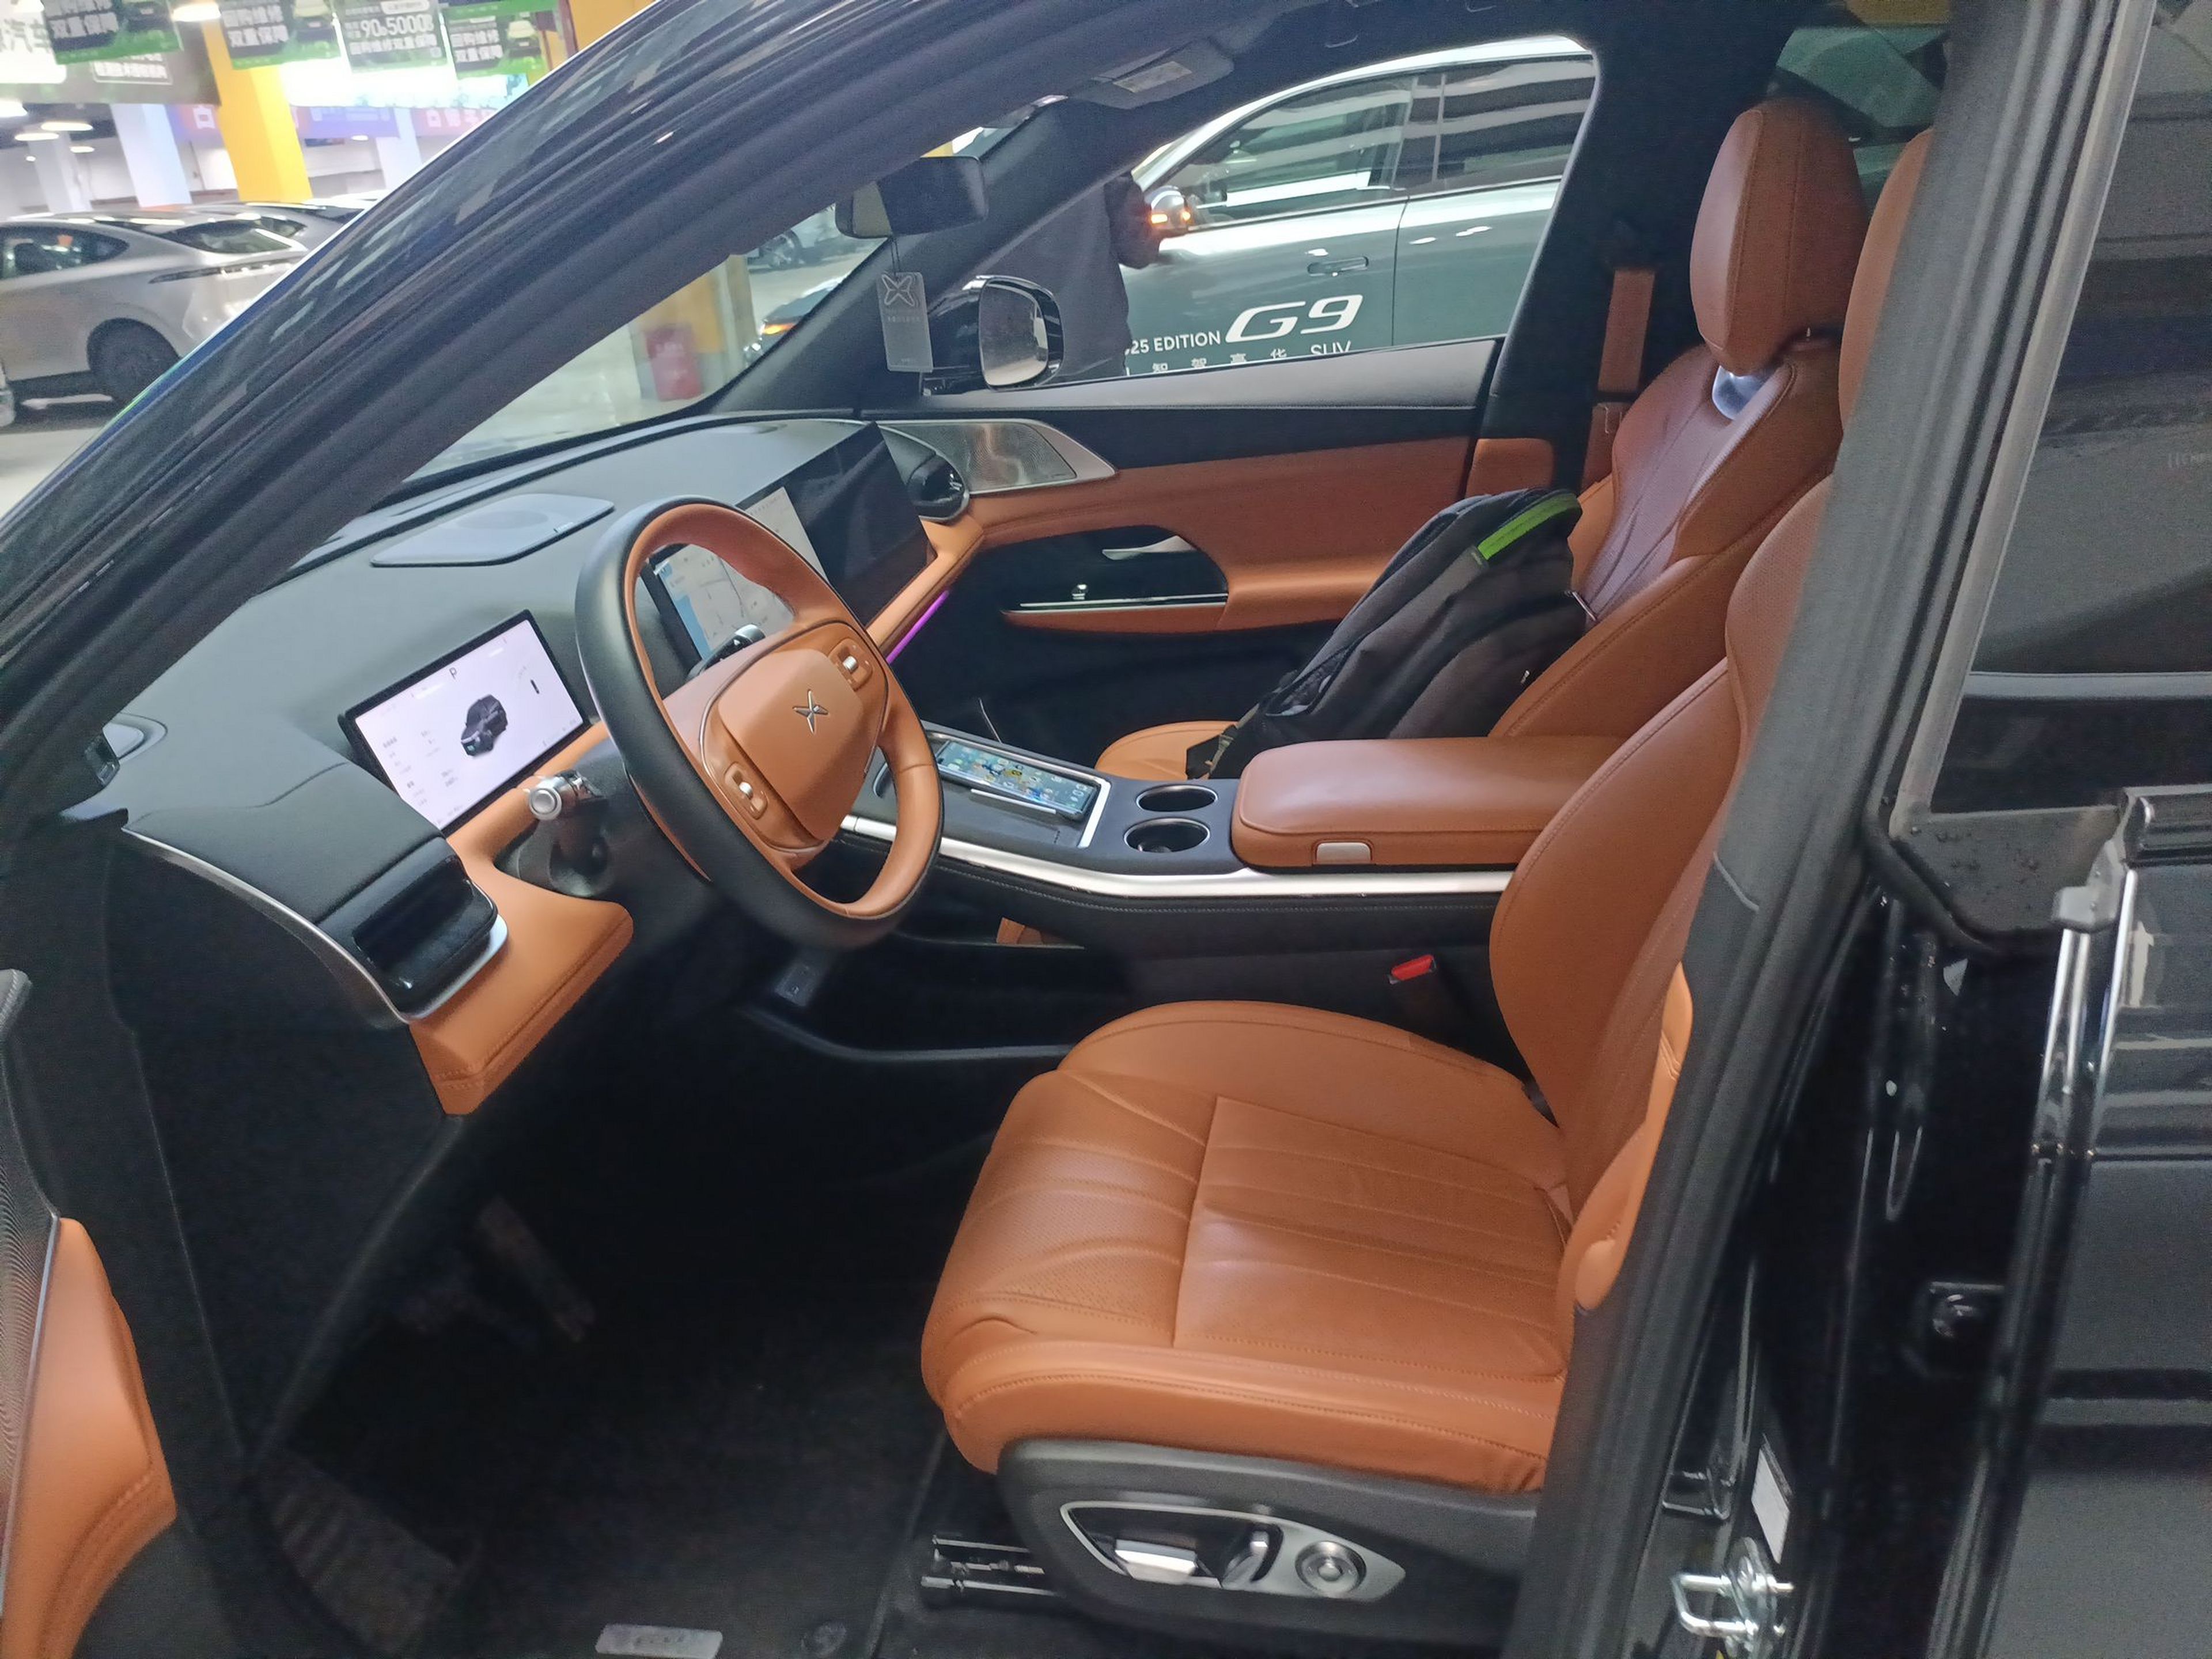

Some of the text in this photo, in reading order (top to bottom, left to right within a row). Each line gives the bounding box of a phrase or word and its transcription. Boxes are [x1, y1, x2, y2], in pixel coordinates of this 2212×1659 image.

[1153, 330, 1221, 352] EDITION
[1225, 294, 1363, 343] G9
[1310, 340, 1352, 355] SUV
